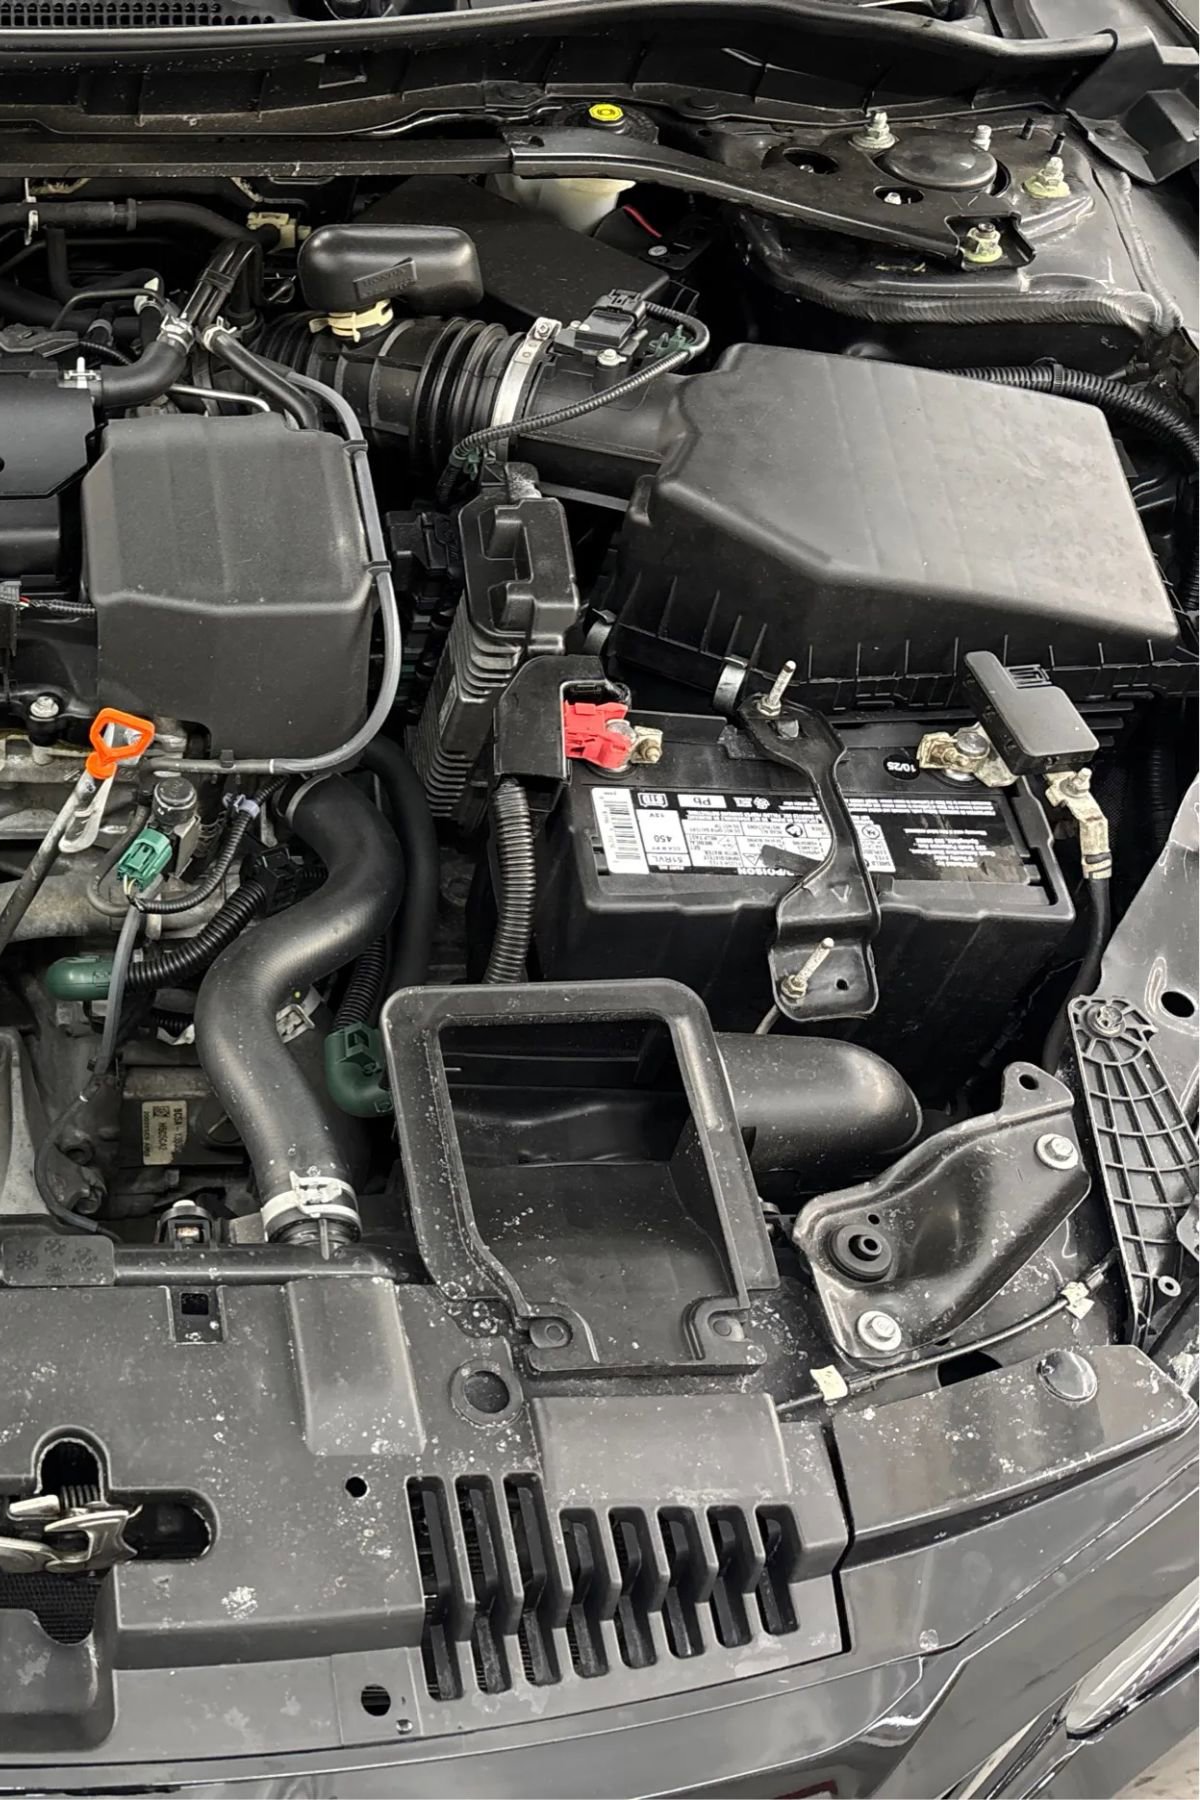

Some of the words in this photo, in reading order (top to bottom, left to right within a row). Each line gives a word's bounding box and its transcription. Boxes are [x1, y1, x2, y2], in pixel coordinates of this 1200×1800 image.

[886, 761, 917, 773] 10/25
[693, 796, 712, 806] Pb
[653, 834, 673, 843] 450
[651, 855, 684, 864] 51RVL
